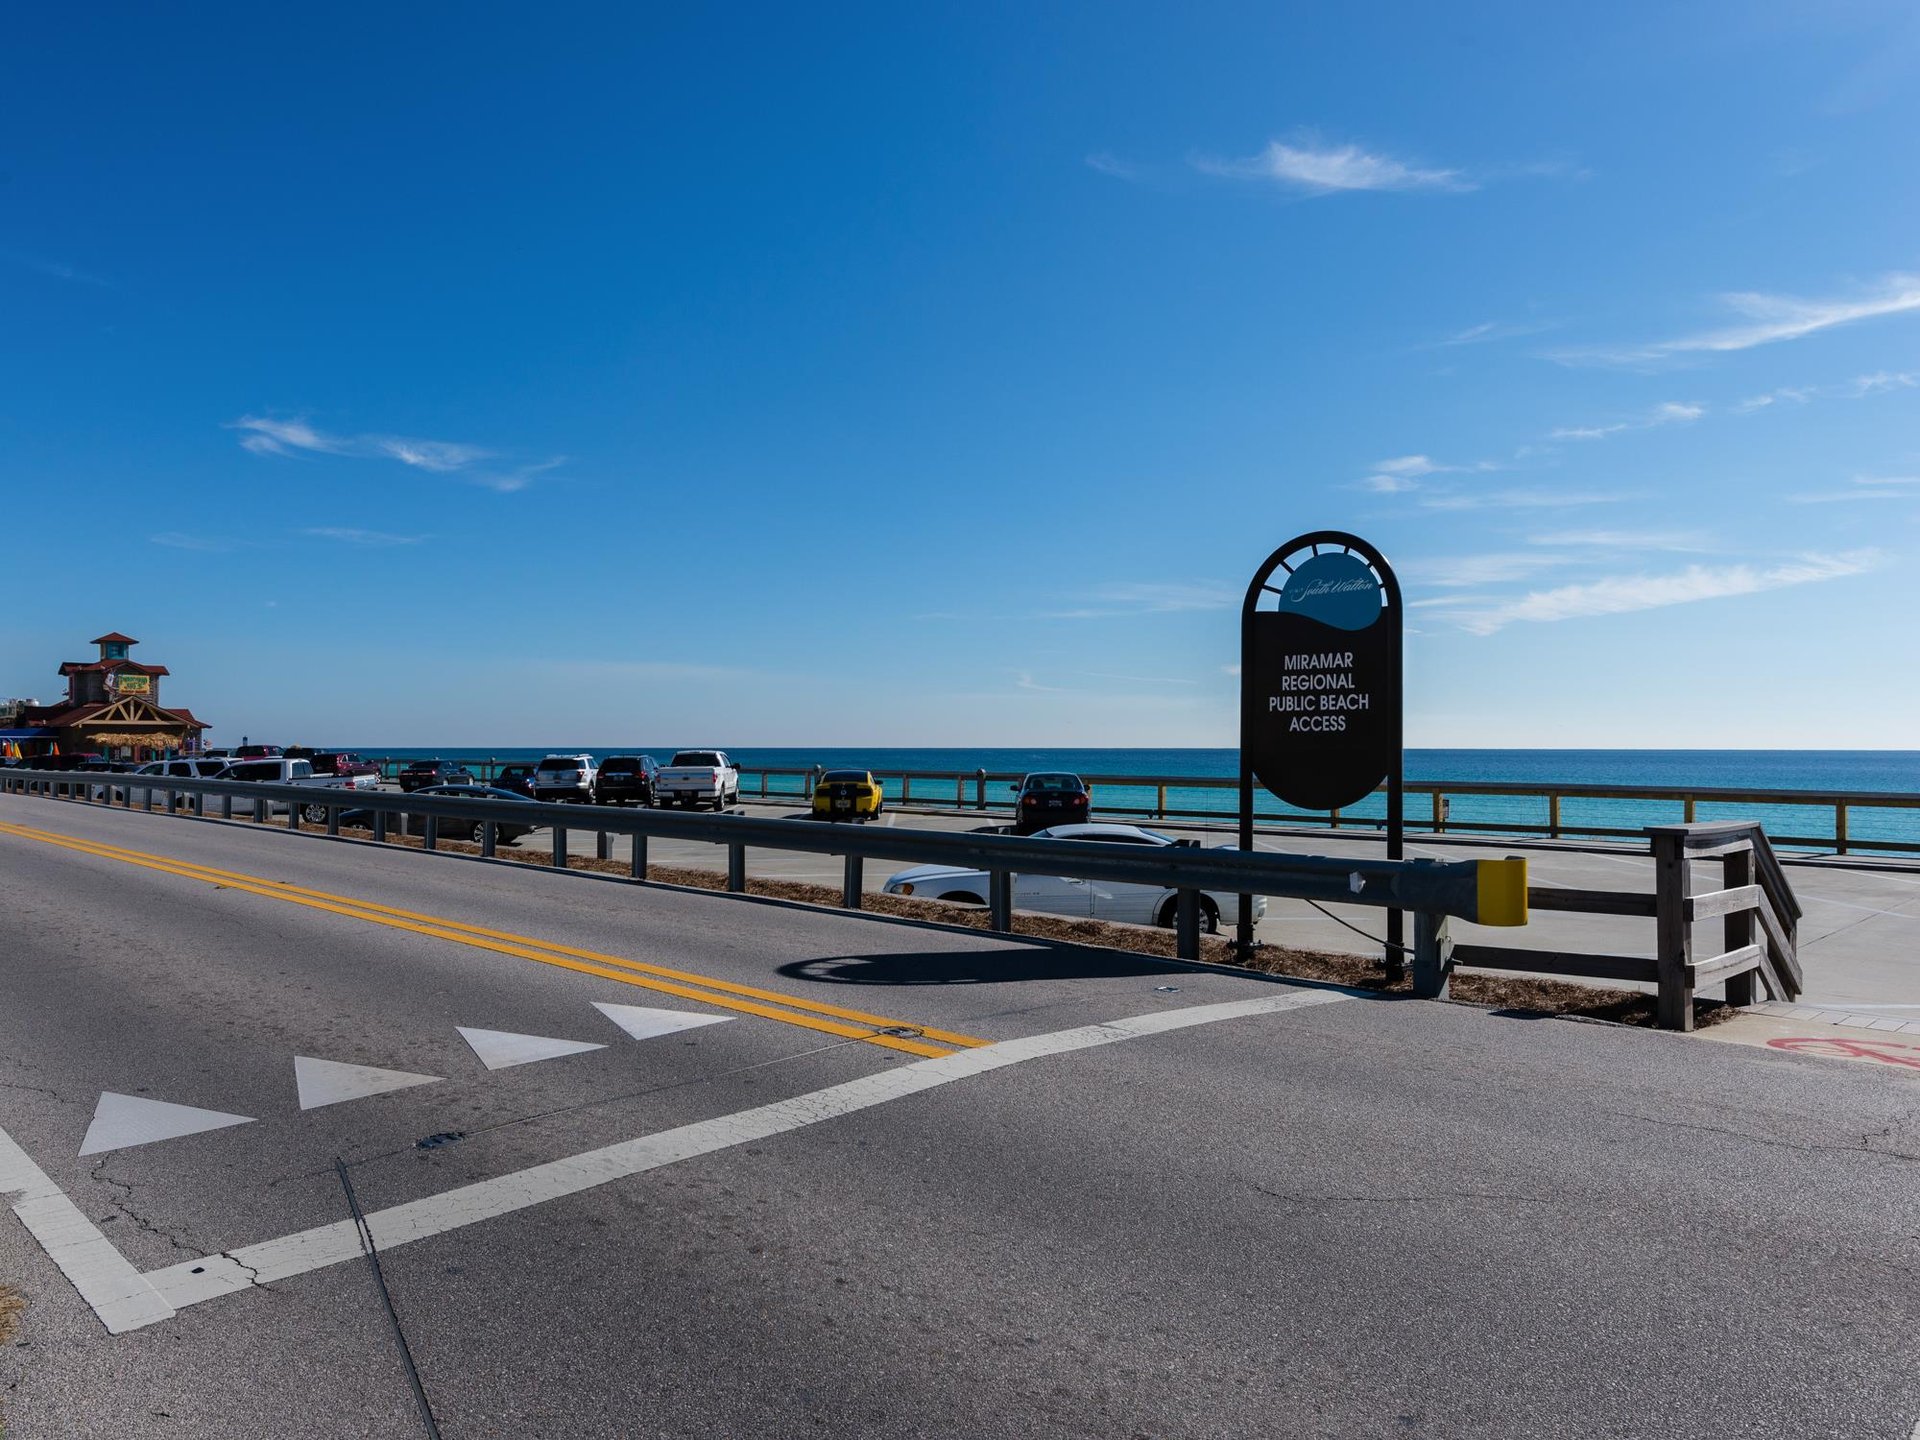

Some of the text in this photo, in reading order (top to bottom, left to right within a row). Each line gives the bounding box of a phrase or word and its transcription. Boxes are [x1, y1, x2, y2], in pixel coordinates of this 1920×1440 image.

[1291, 578, 1373, 602] South Walton
[1284, 652, 1353, 670] MIRAMAR
[1282, 673, 1355, 691] REGIONAL
[1269, 693, 1369, 712] PUBLIC BEACH
[1289, 715, 1346, 732] ACCESS
